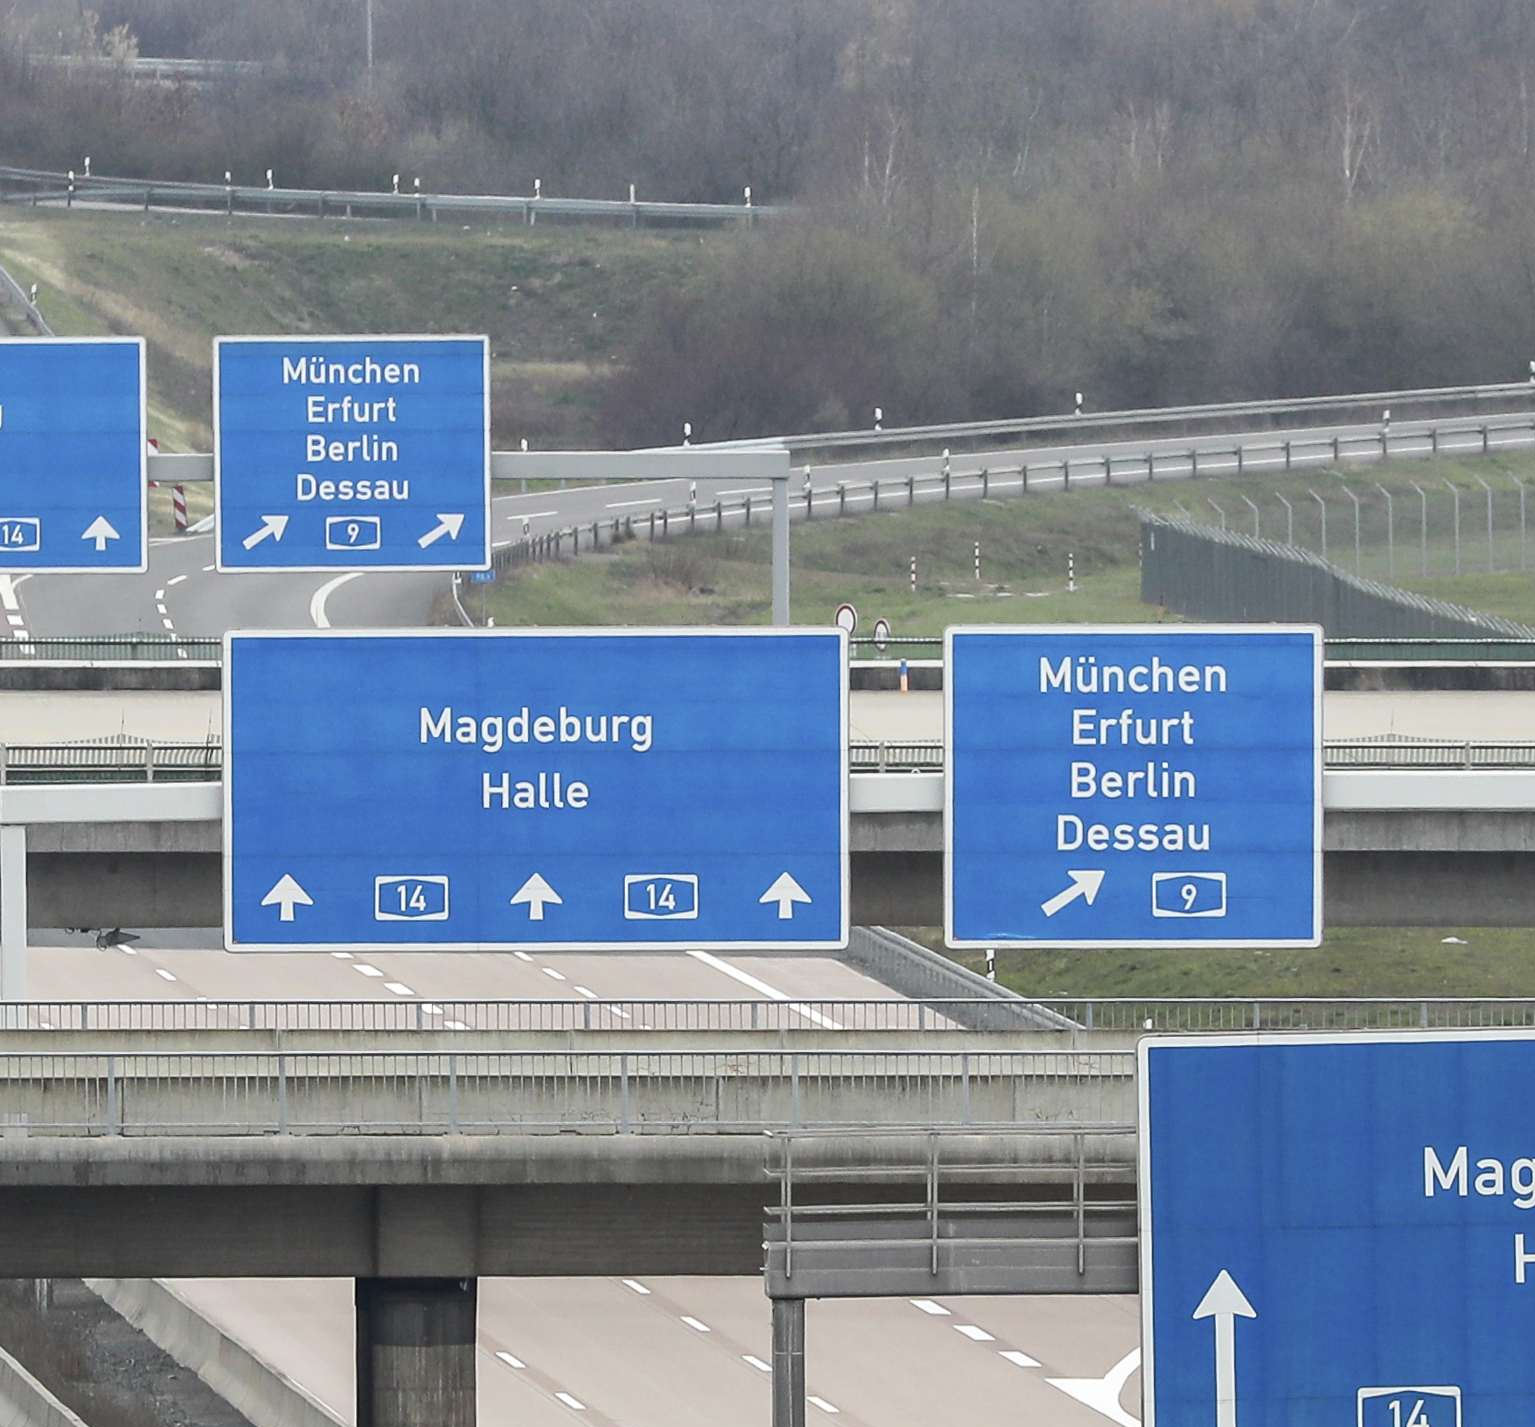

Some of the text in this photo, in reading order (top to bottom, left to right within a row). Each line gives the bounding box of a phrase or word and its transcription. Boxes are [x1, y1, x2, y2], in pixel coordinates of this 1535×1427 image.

[283, 356, 420, 384] München
[307, 395, 397, 423] Erfurt
[306, 434, 398, 462] Berlin
[297, 473, 409, 501] Dessau
[2, 524, 24, 545] 14
[347, 523, 360, 544] 9
[1040, 656, 1227, 693] München
[420, 706, 652, 753] Magdeburg
[1072, 708, 1194, 745] Erfurt
[482, 772, 589, 809] Halle
[1071, 761, 1195, 798] Berlin
[1057, 814, 1210, 851] Dessau
[397, 884, 427, 912] 14
[646, 883, 676, 910] 14
[1181, 883, 1197, 910] 9
